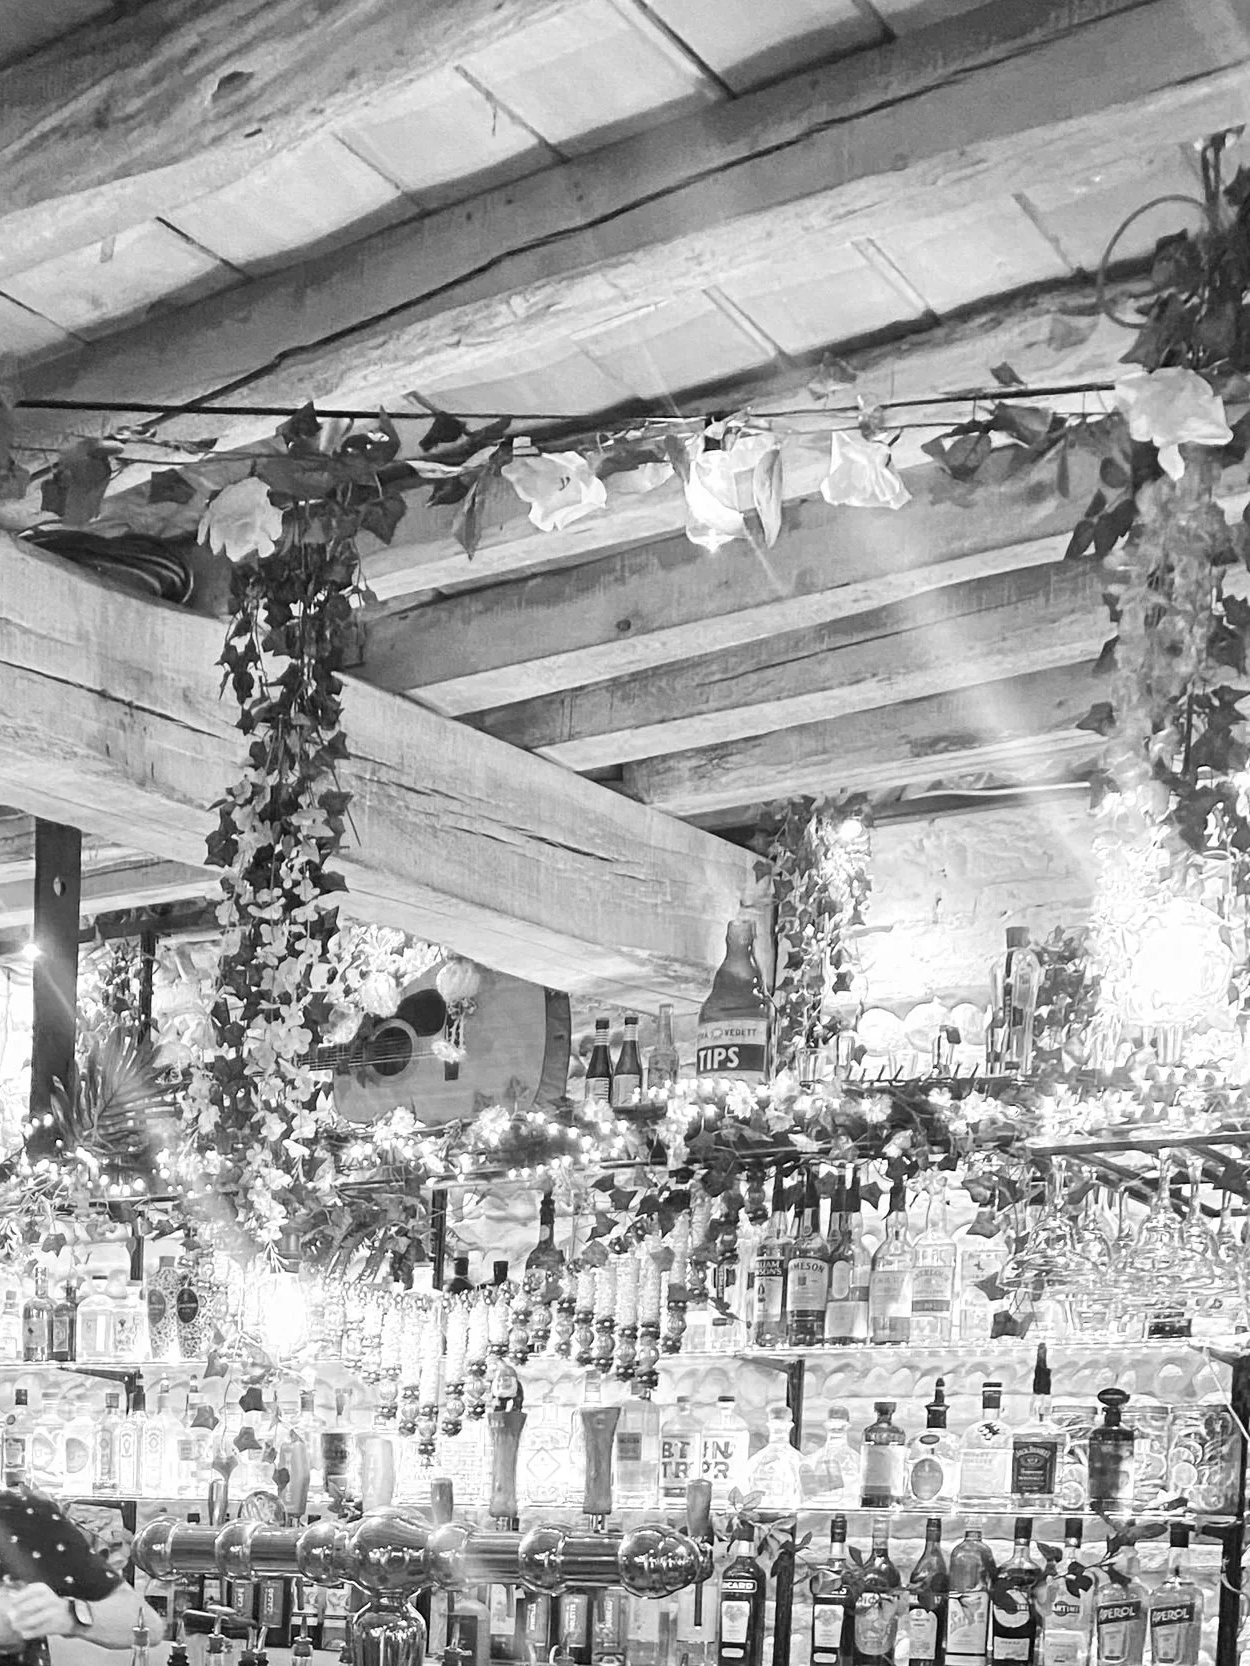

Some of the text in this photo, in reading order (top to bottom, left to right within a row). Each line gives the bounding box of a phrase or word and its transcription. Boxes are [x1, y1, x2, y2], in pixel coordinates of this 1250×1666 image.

[699, 1046, 740, 1072] TIPS
[1098, 1606, 1136, 1621] APEROL
[1151, 1608, 1190, 1622] APEROL
